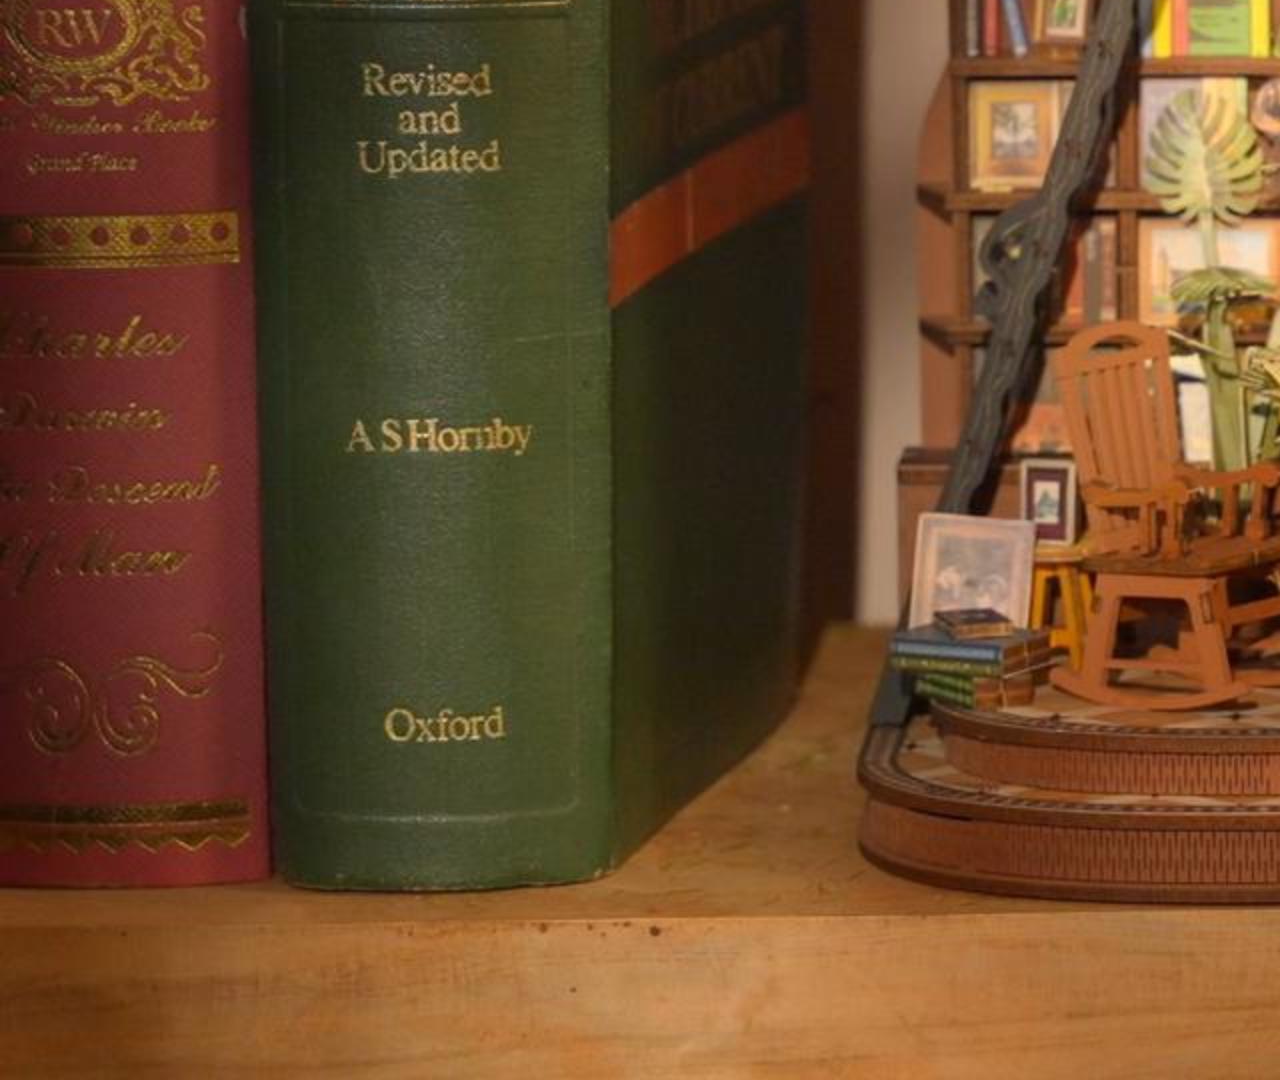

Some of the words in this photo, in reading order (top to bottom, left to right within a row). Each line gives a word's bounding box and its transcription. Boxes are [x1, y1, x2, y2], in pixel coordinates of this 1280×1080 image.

[363, 62, 492, 98] Revised
[398, 102, 463, 135] and
[357, 139, 502, 179] Updated
[407, 417, 533, 457] Hornby
[384, 707, 507, 743] Oxford
